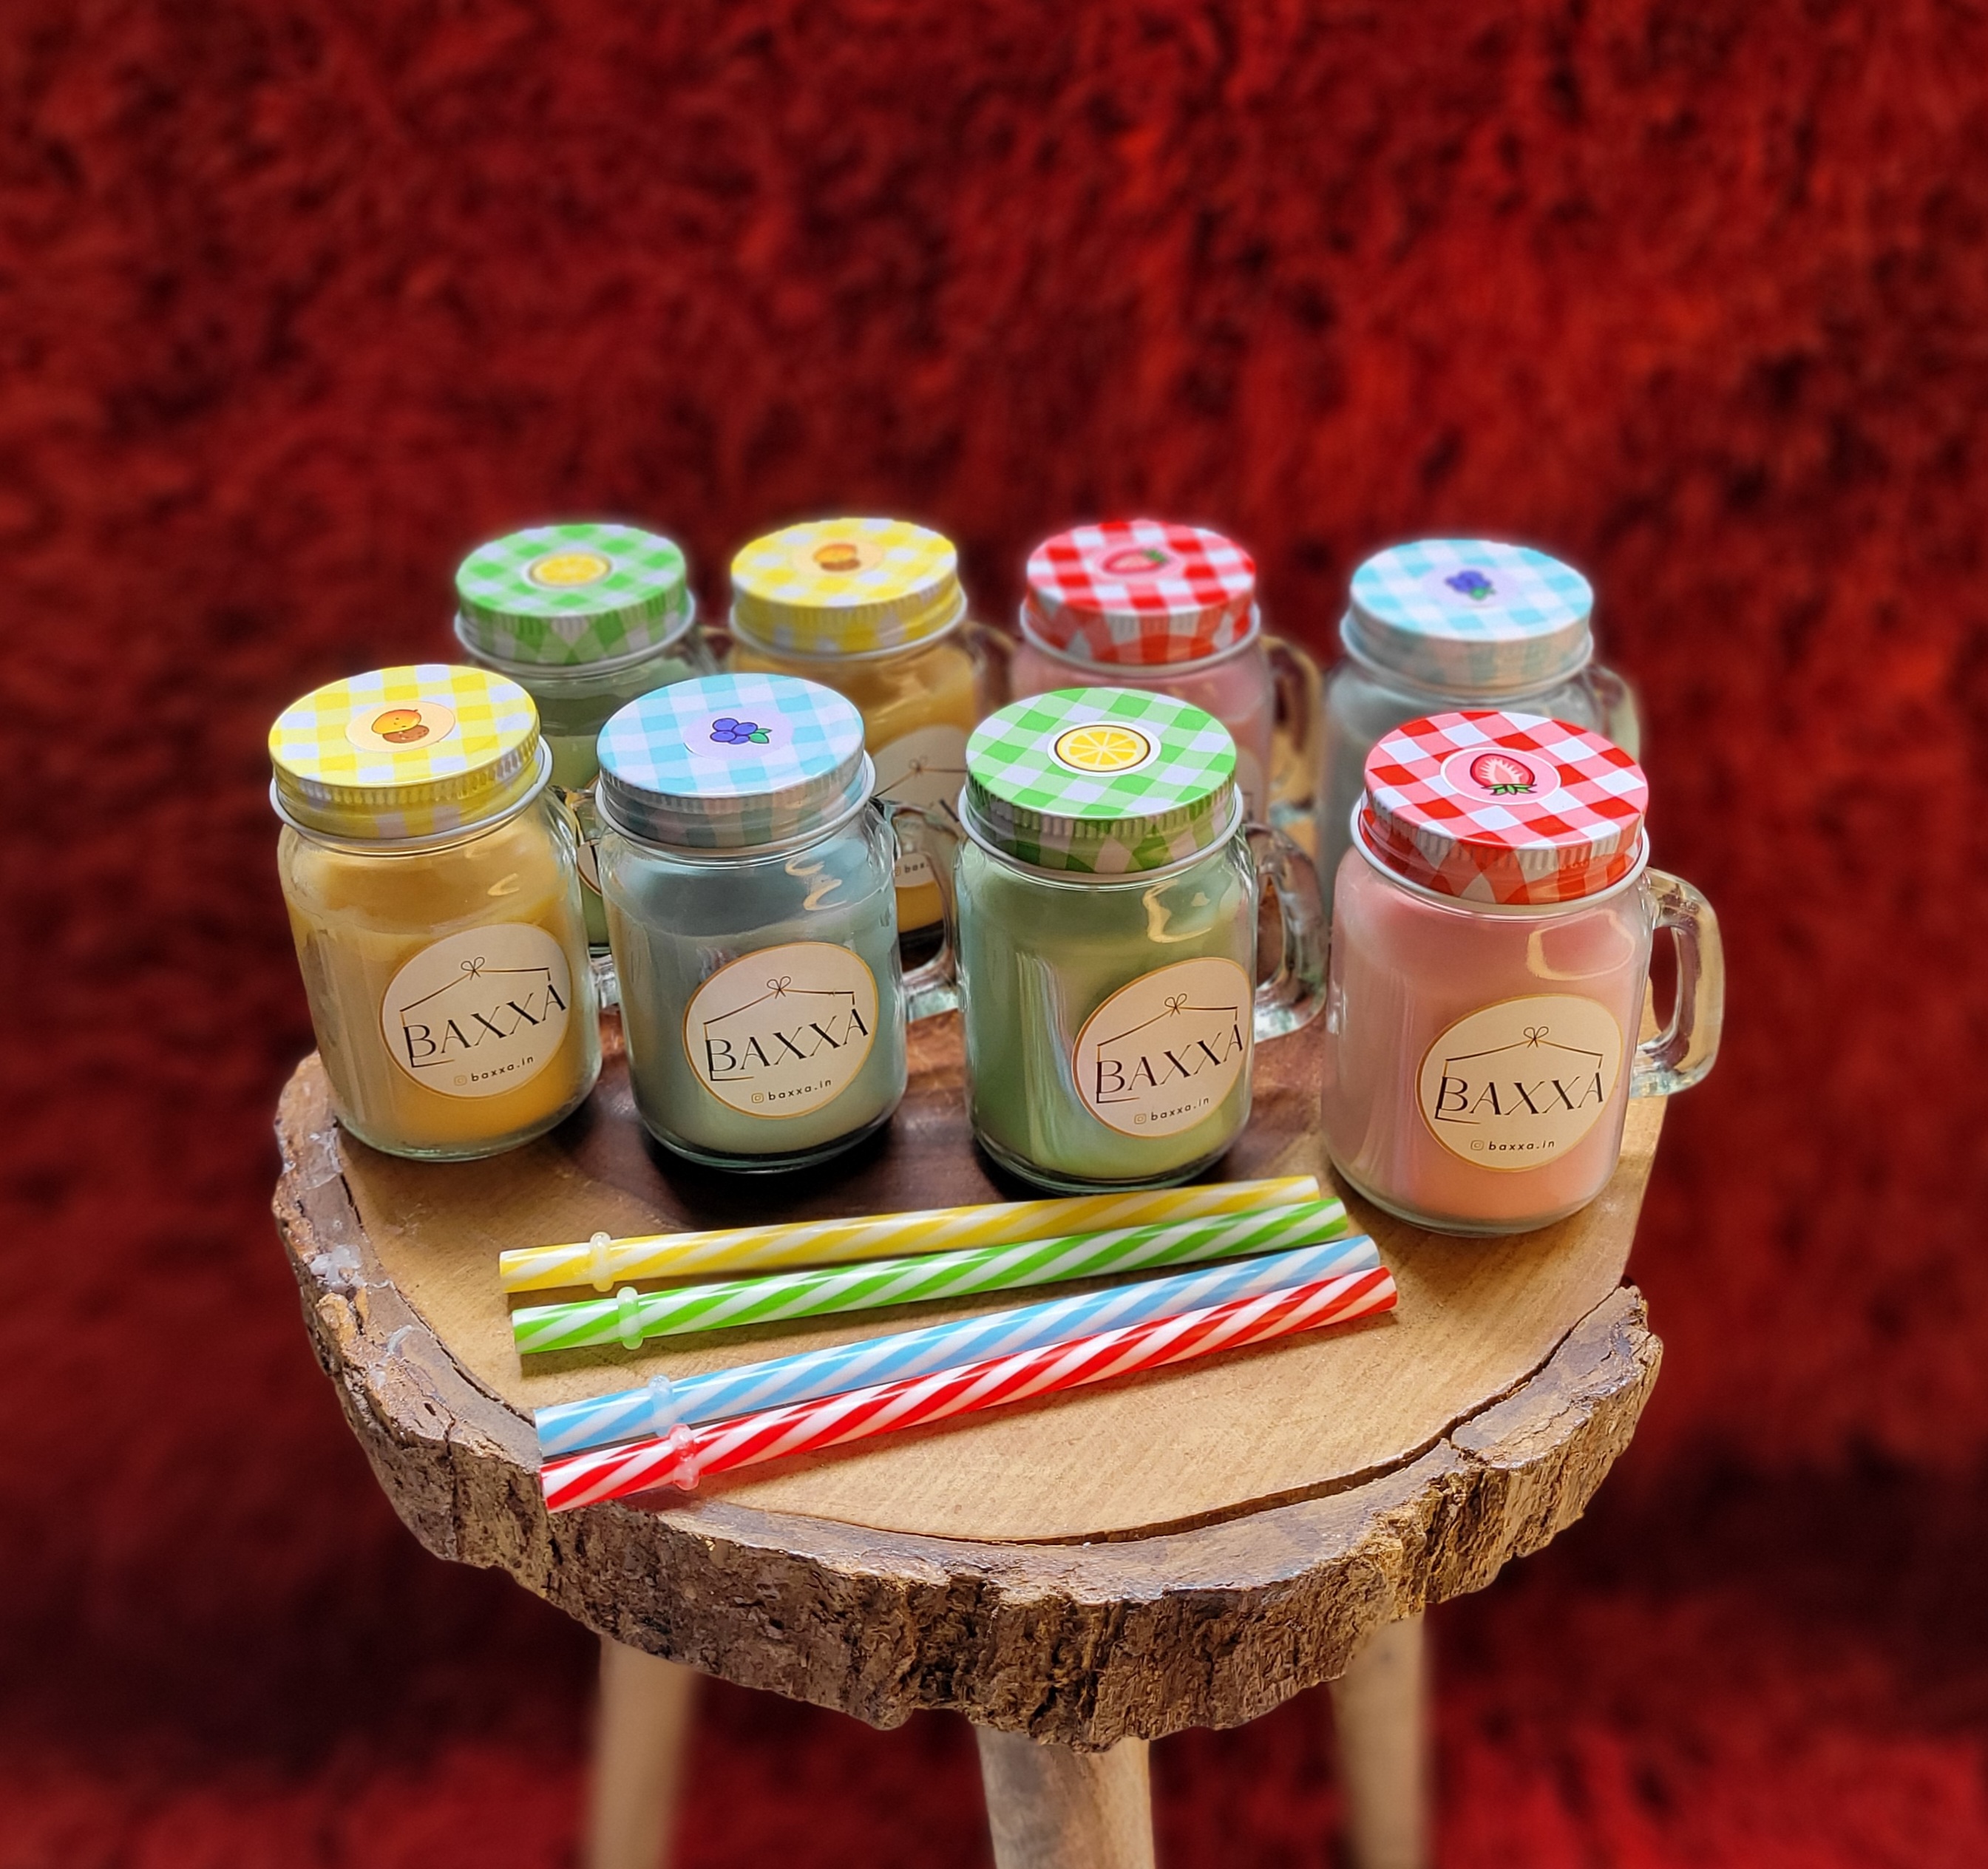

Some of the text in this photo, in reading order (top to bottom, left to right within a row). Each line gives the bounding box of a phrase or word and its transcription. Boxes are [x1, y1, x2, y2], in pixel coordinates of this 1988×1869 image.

[403, 983, 566, 1058] BAXXA
[705, 1008, 868, 1071] BAXXA
[471, 1056, 534, 1082] baxxa.in
[1096, 1024, 1243, 1093] BAXXA
[768, 1079, 831, 1101] baxxa.in
[1436, 1072, 1604, 1115] BAXXA
[1150, 1097, 1210, 1121] baxxa.in
[1488, 1140, 1555, 1151] baxxa.in
